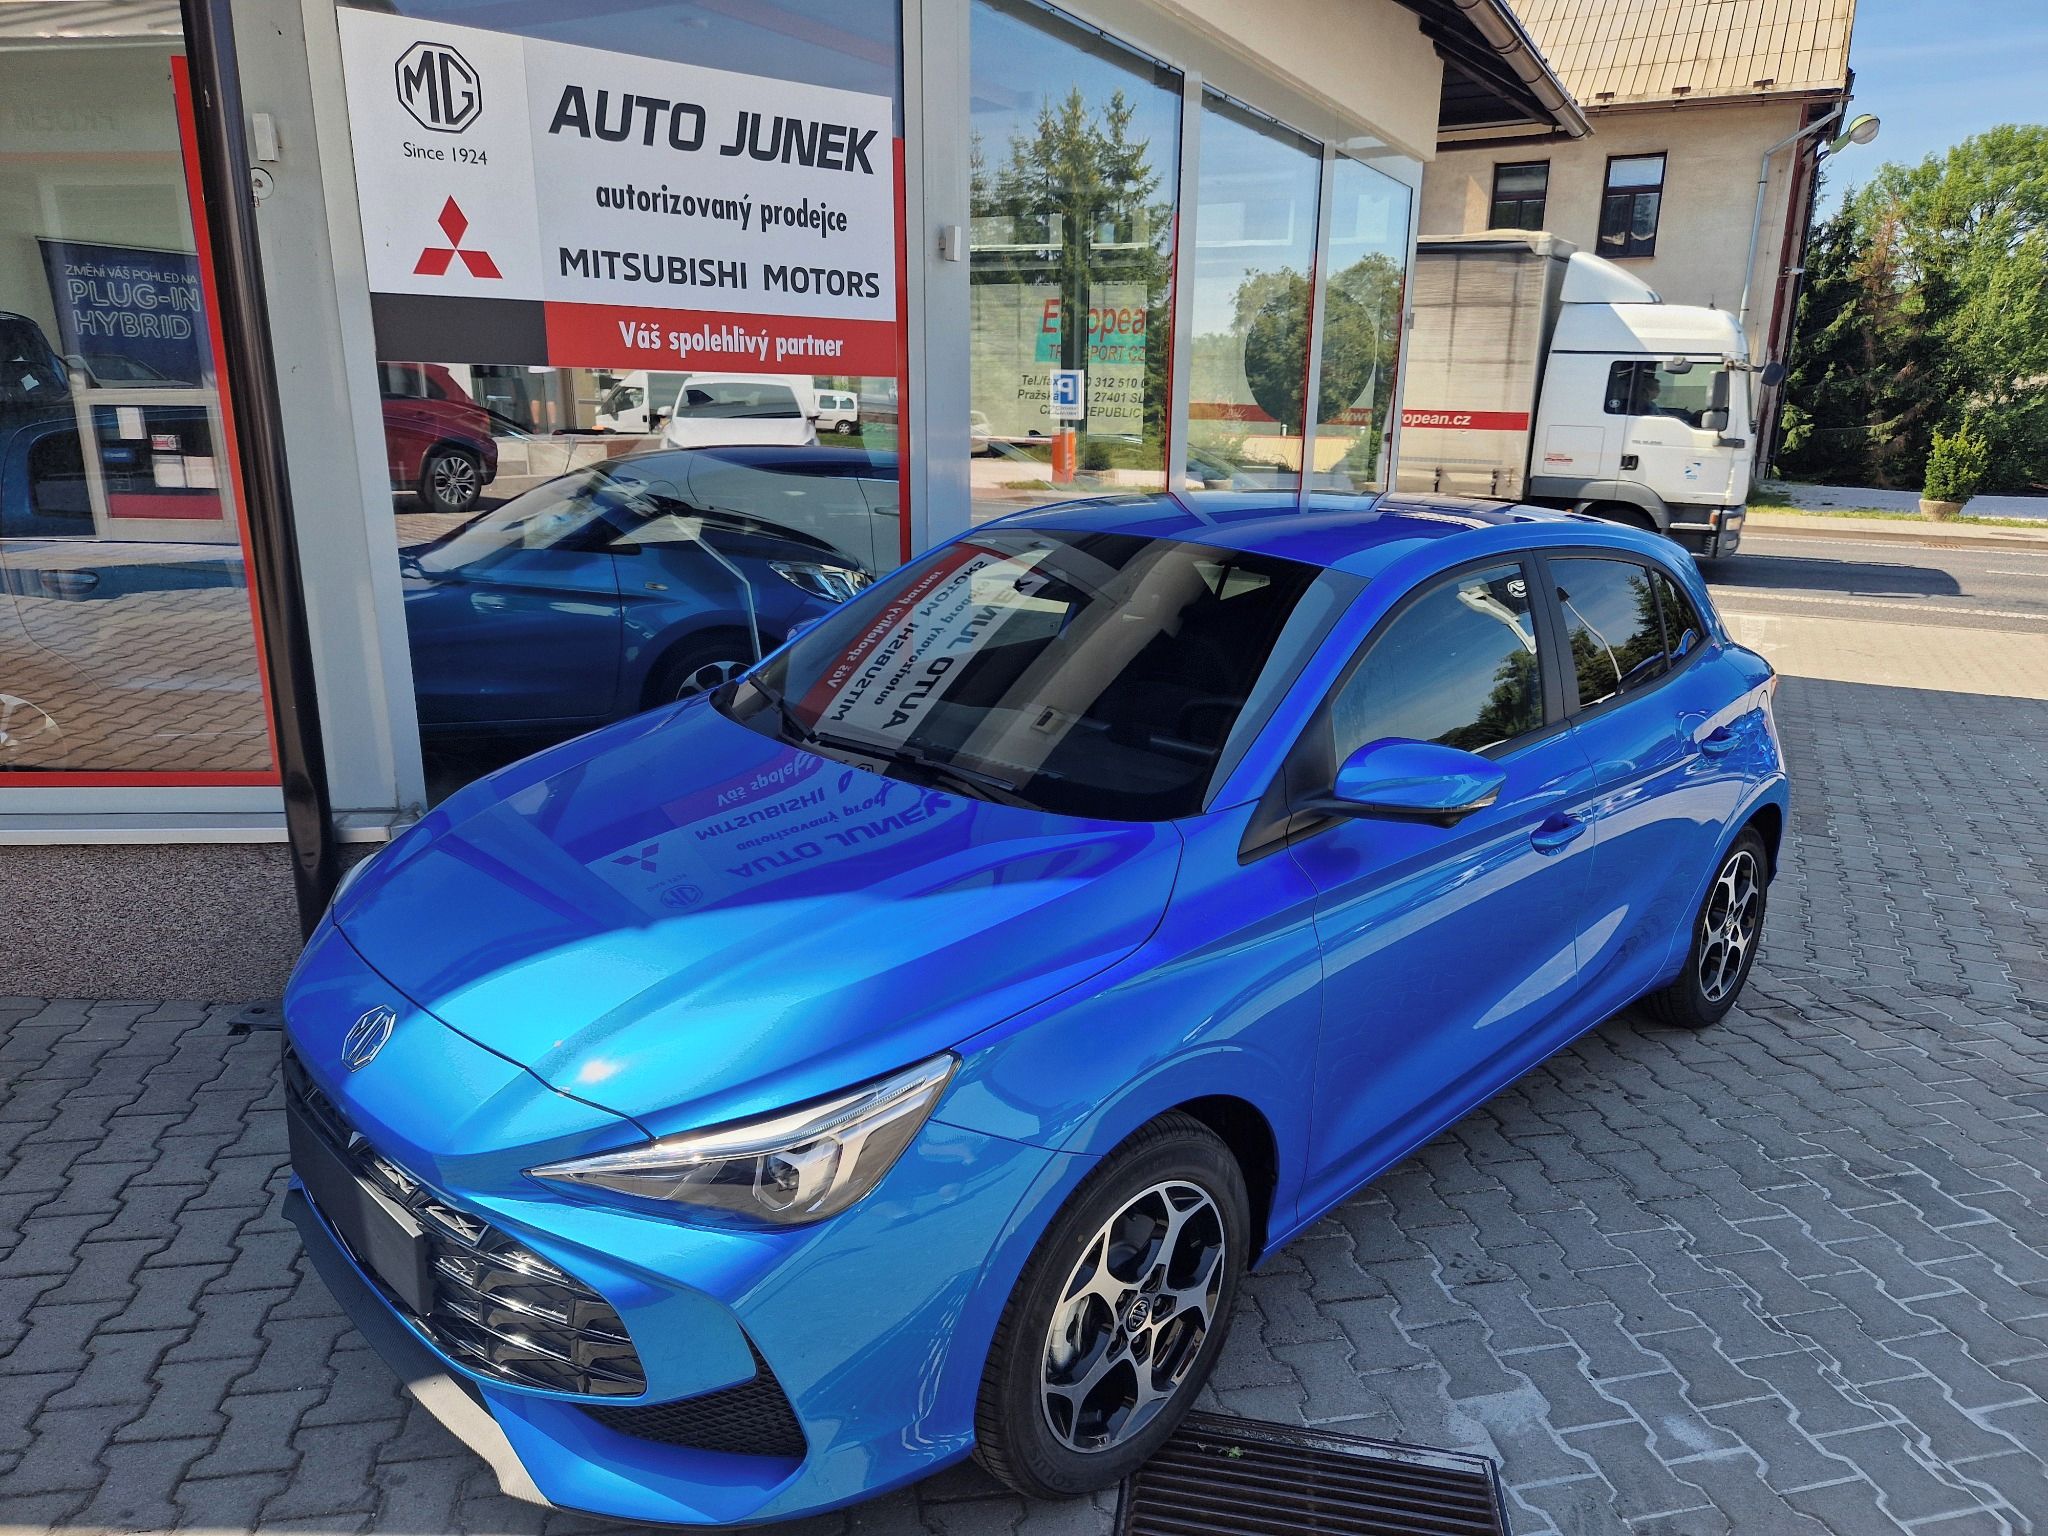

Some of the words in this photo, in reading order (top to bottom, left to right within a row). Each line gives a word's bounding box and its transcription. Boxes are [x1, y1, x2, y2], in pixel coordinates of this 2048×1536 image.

[403, 50, 475, 125] MG
[548, 85, 707, 151] AUTO
[719, 111, 878, 175] JUNEK
[402, 142, 445, 162] Since
[451, 146, 488, 166] 1924
[595, 183, 752, 231] autorizovaný
[759, 197, 848, 239] prodejce
[64, 263, 105, 277] ZMĚNÍ
[107, 265, 130, 280] VÁŠ
[132, 269, 179, 284] POHLED
[181, 275, 198, 286] NA
[559, 247, 747, 289] MITSUBISHI
[763, 264, 881, 299] MOTORS
[67, 278, 201, 312] PLUG-IN
[72, 310, 191, 339] HYBRID
[618, 320, 662, 350] Váš
[668, 324, 769, 362] spolehlivý
[776, 335, 843, 362] partner
[1094, 391, 1125, 403] 27401
[1095, 377, 1114, 388] 312
[1118, 378, 1137, 388] 510
[1401, 413, 1471, 426] opean.cz
